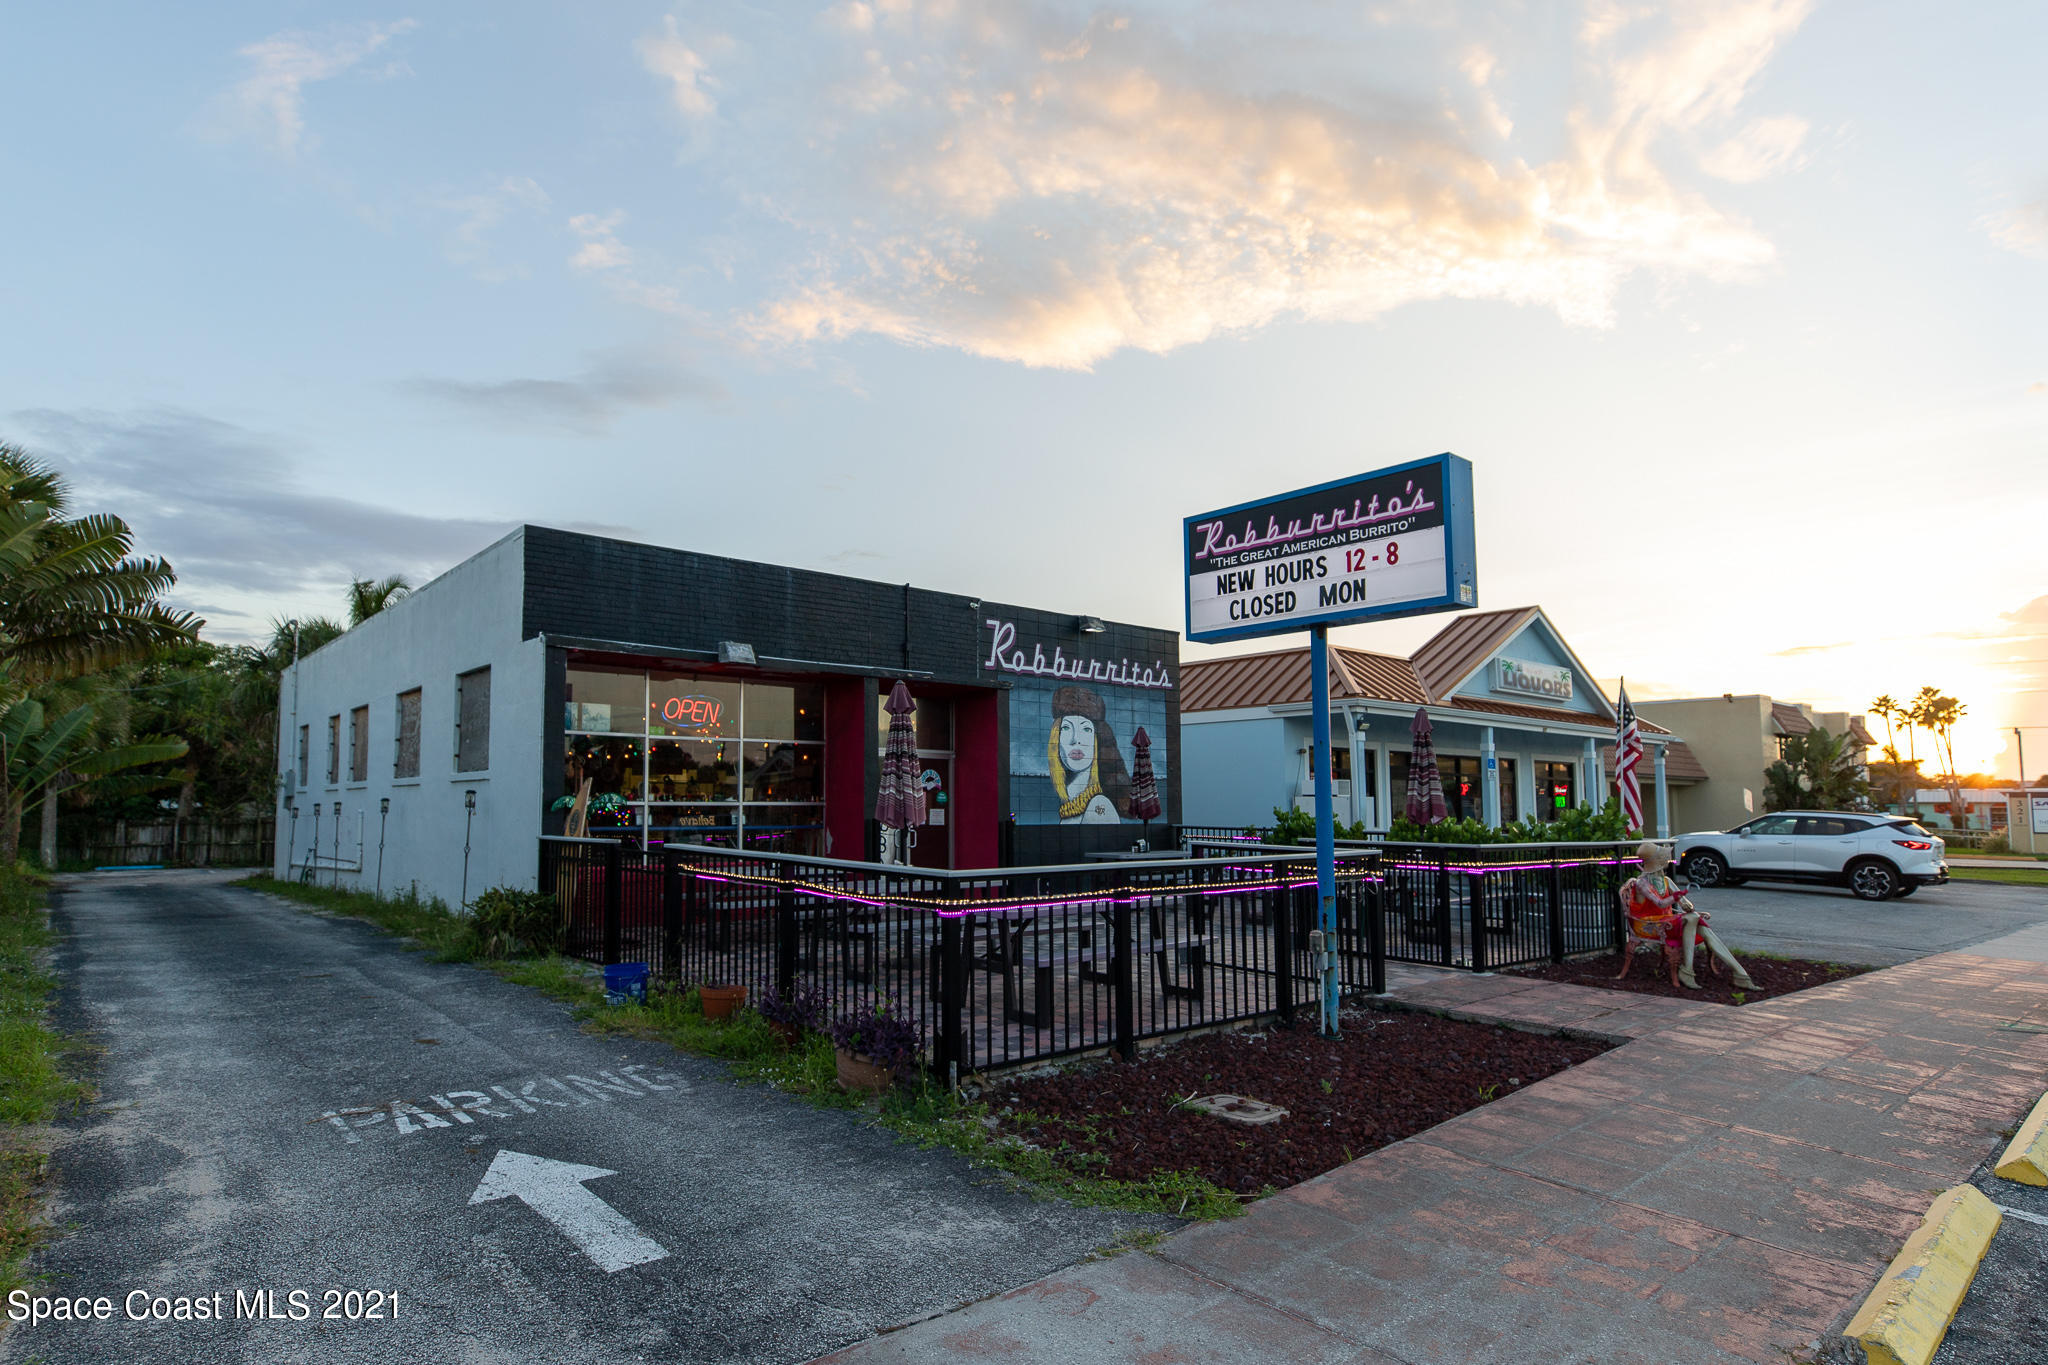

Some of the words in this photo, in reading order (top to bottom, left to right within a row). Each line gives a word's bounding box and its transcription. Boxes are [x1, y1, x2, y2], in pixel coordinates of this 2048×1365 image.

[1195, 480, 1435, 560] Robburrito's
[1217, 569, 1255, 595] NEW
[1265, 556, 1328, 587] HOURS
[1345, 548, 1366, 573] 12
[1386, 541, 1399, 565] 8
[1229, 590, 1297, 621] CLOSED
[1319, 578, 1366, 608] MON
[985, 619, 1173, 689] Robburrito's
[664, 697, 720, 723] OPEN
[1503, 671, 1571, 697] LIQUORS
[323, 1065, 693, 1145] PARKING
